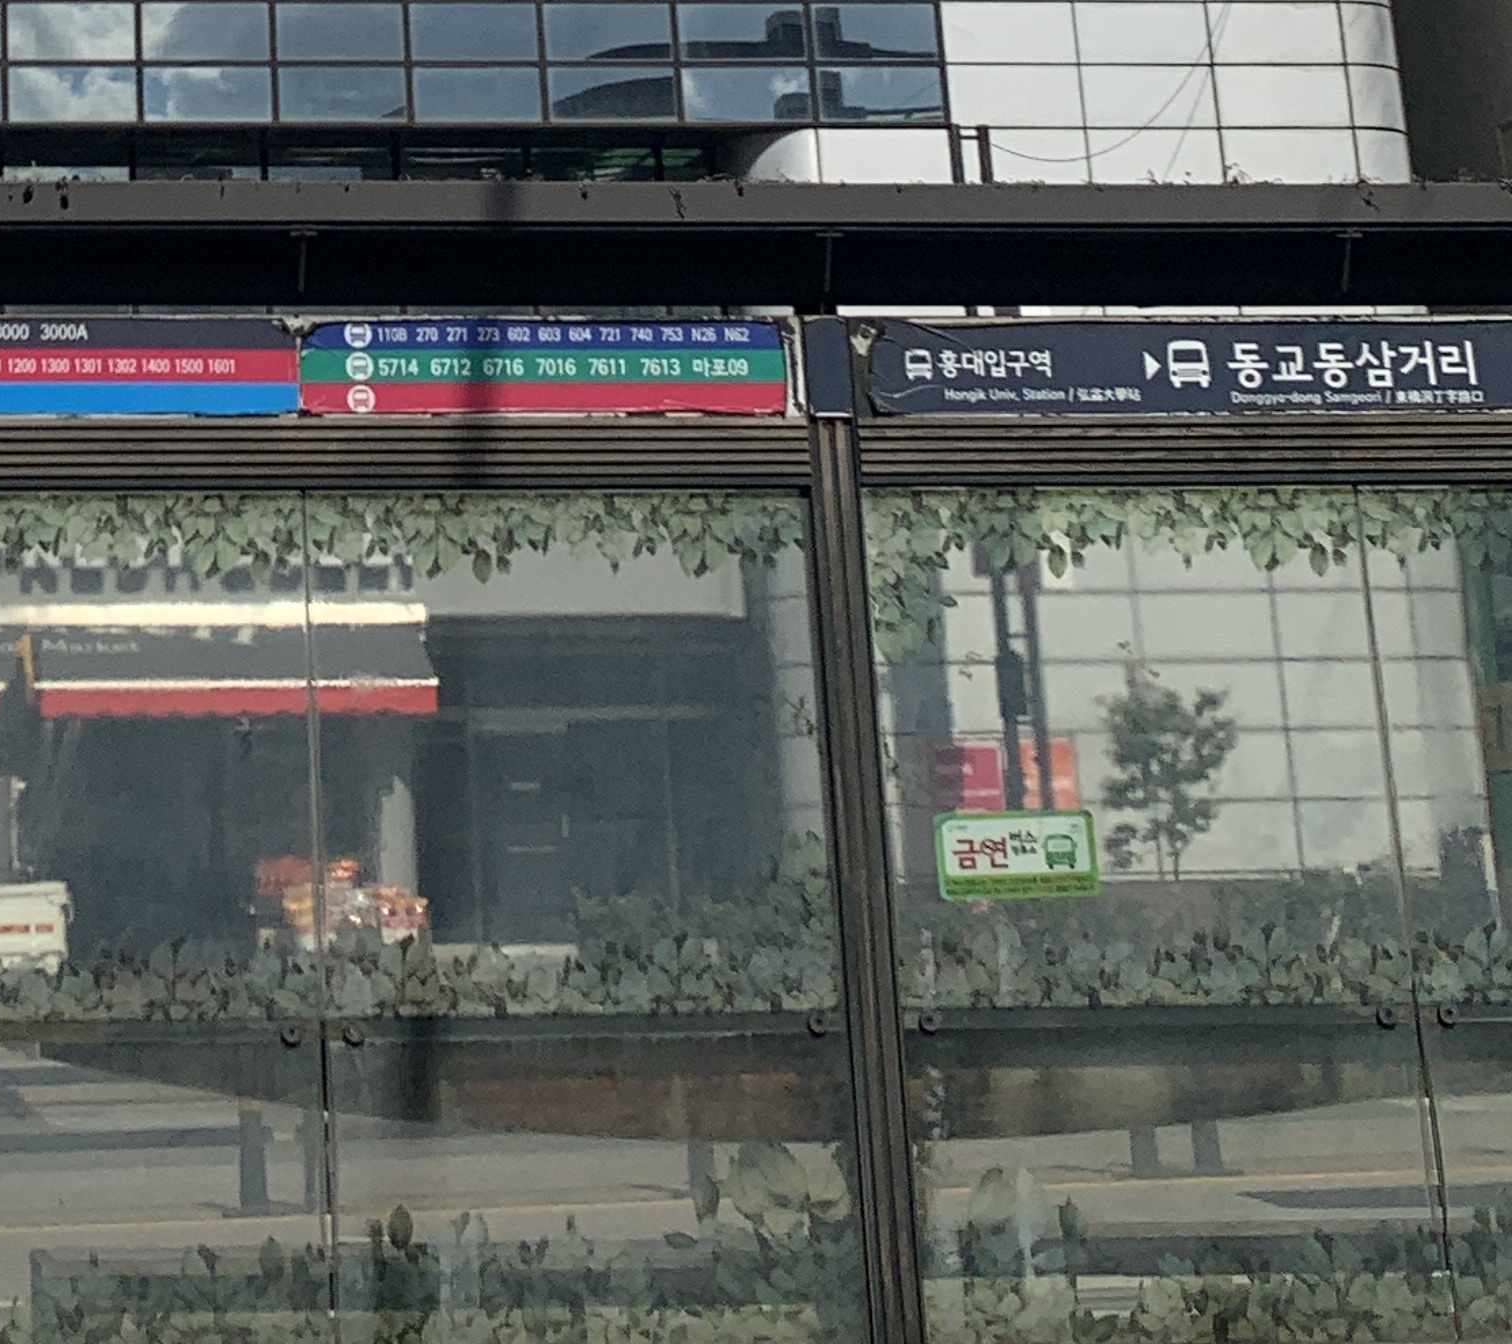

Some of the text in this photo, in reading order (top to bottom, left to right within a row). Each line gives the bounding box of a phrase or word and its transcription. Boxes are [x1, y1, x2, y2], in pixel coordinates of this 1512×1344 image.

[40, 323, 88, 341] 3000A
[446, 326, 468, 343] 271
[599, 326, 621, 343] 721
[660, 326, 683, 343] 753
[378, 357, 750, 377] 5714 6712 6716 7016 7611 7613 마포09
[939, 349, 1053, 378] 홍대입구역
[1227, 340, 1479, 388] 동교동삼거리
[944, 387, 987, 404] Hongik
[1023, 387, 1066, 401] Station
[952, 836, 1009, 870] 금연
